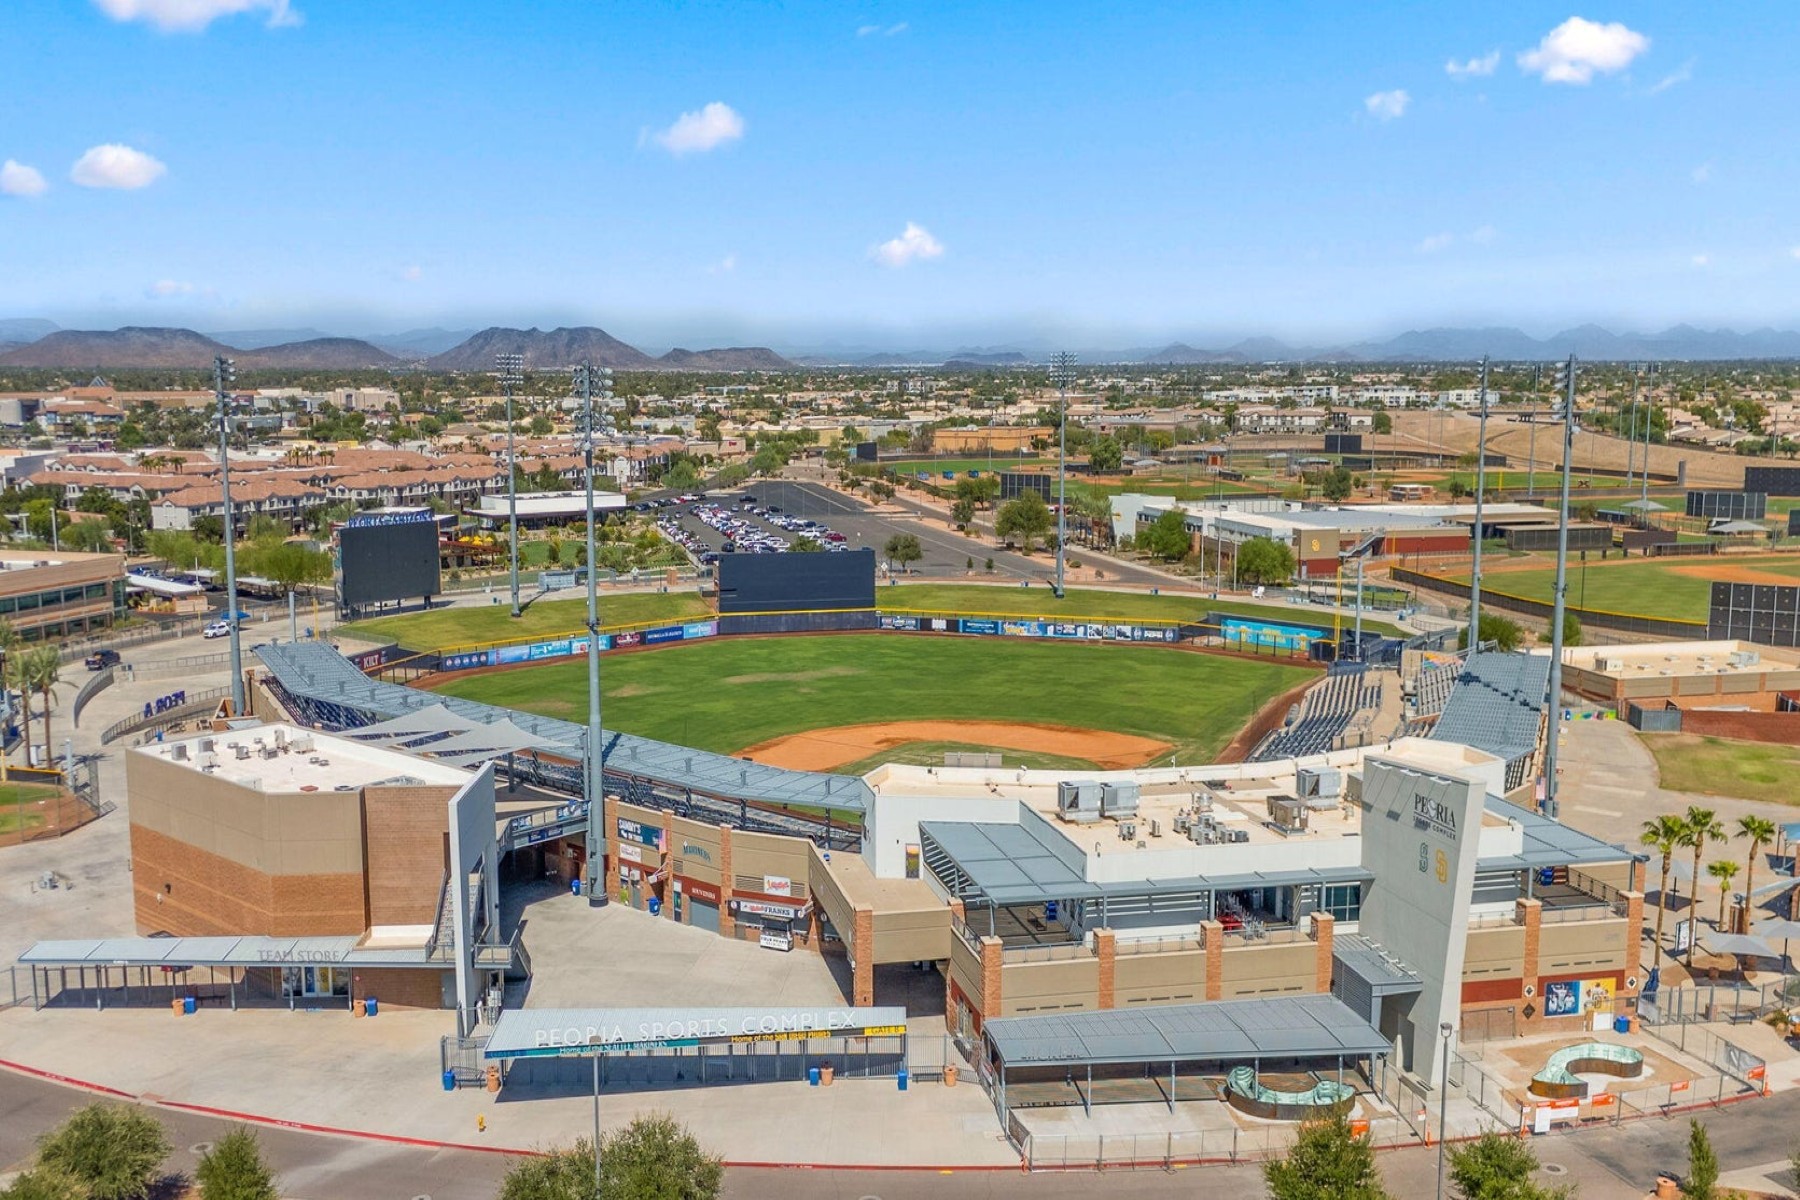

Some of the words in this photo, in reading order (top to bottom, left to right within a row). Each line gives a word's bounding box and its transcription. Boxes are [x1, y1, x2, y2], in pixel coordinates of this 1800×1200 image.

[1414, 792, 1456, 828] PEORIA
[1432, 824, 1456, 841] COMPLEX
[764, 906, 791, 916] FRANKS
[257, 950, 293, 961] TEAM
[297, 950, 339, 961] STORE
[639, 1018, 728, 1041] SPORTS
[742, 1011, 856, 1034] COMPLEX
[732, 1034, 753, 1043] Home
[560, 1046, 580, 1055] Home
